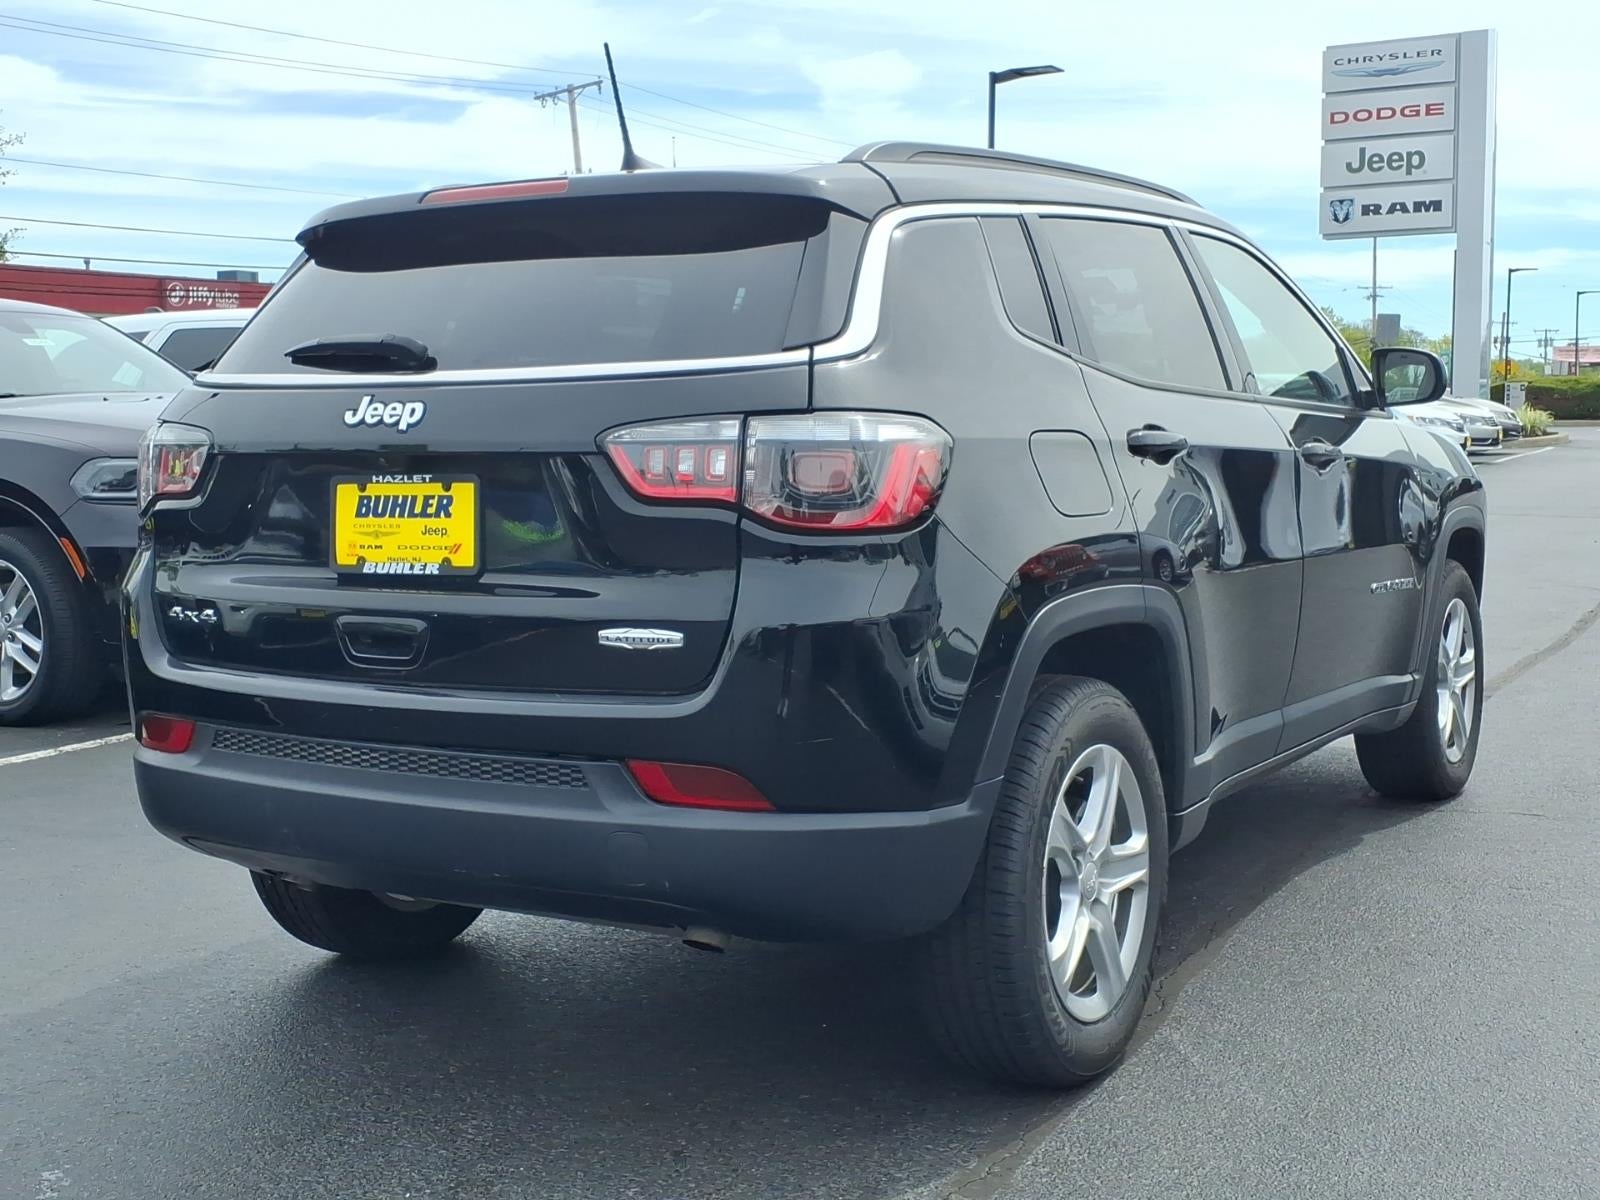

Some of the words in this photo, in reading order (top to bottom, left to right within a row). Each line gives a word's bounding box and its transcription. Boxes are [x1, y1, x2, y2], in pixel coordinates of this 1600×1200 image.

[1333, 48, 1444, 65] CHRYSLER
[1329, 102, 1445, 125] DODGE
[1345, 147, 1426, 176] Jeep
[1361, 199, 1443, 216] RAM
[343, 394, 426, 432] Jeep
[372, 474, 433, 483] HAZLET
[354, 494, 454, 519] BUHLER
[421, 525, 448, 538] Jeep
[362, 562, 440, 575] BUHLER
[169, 606, 217, 623] 4x4
[604, 635, 673, 643] LATITUDE
